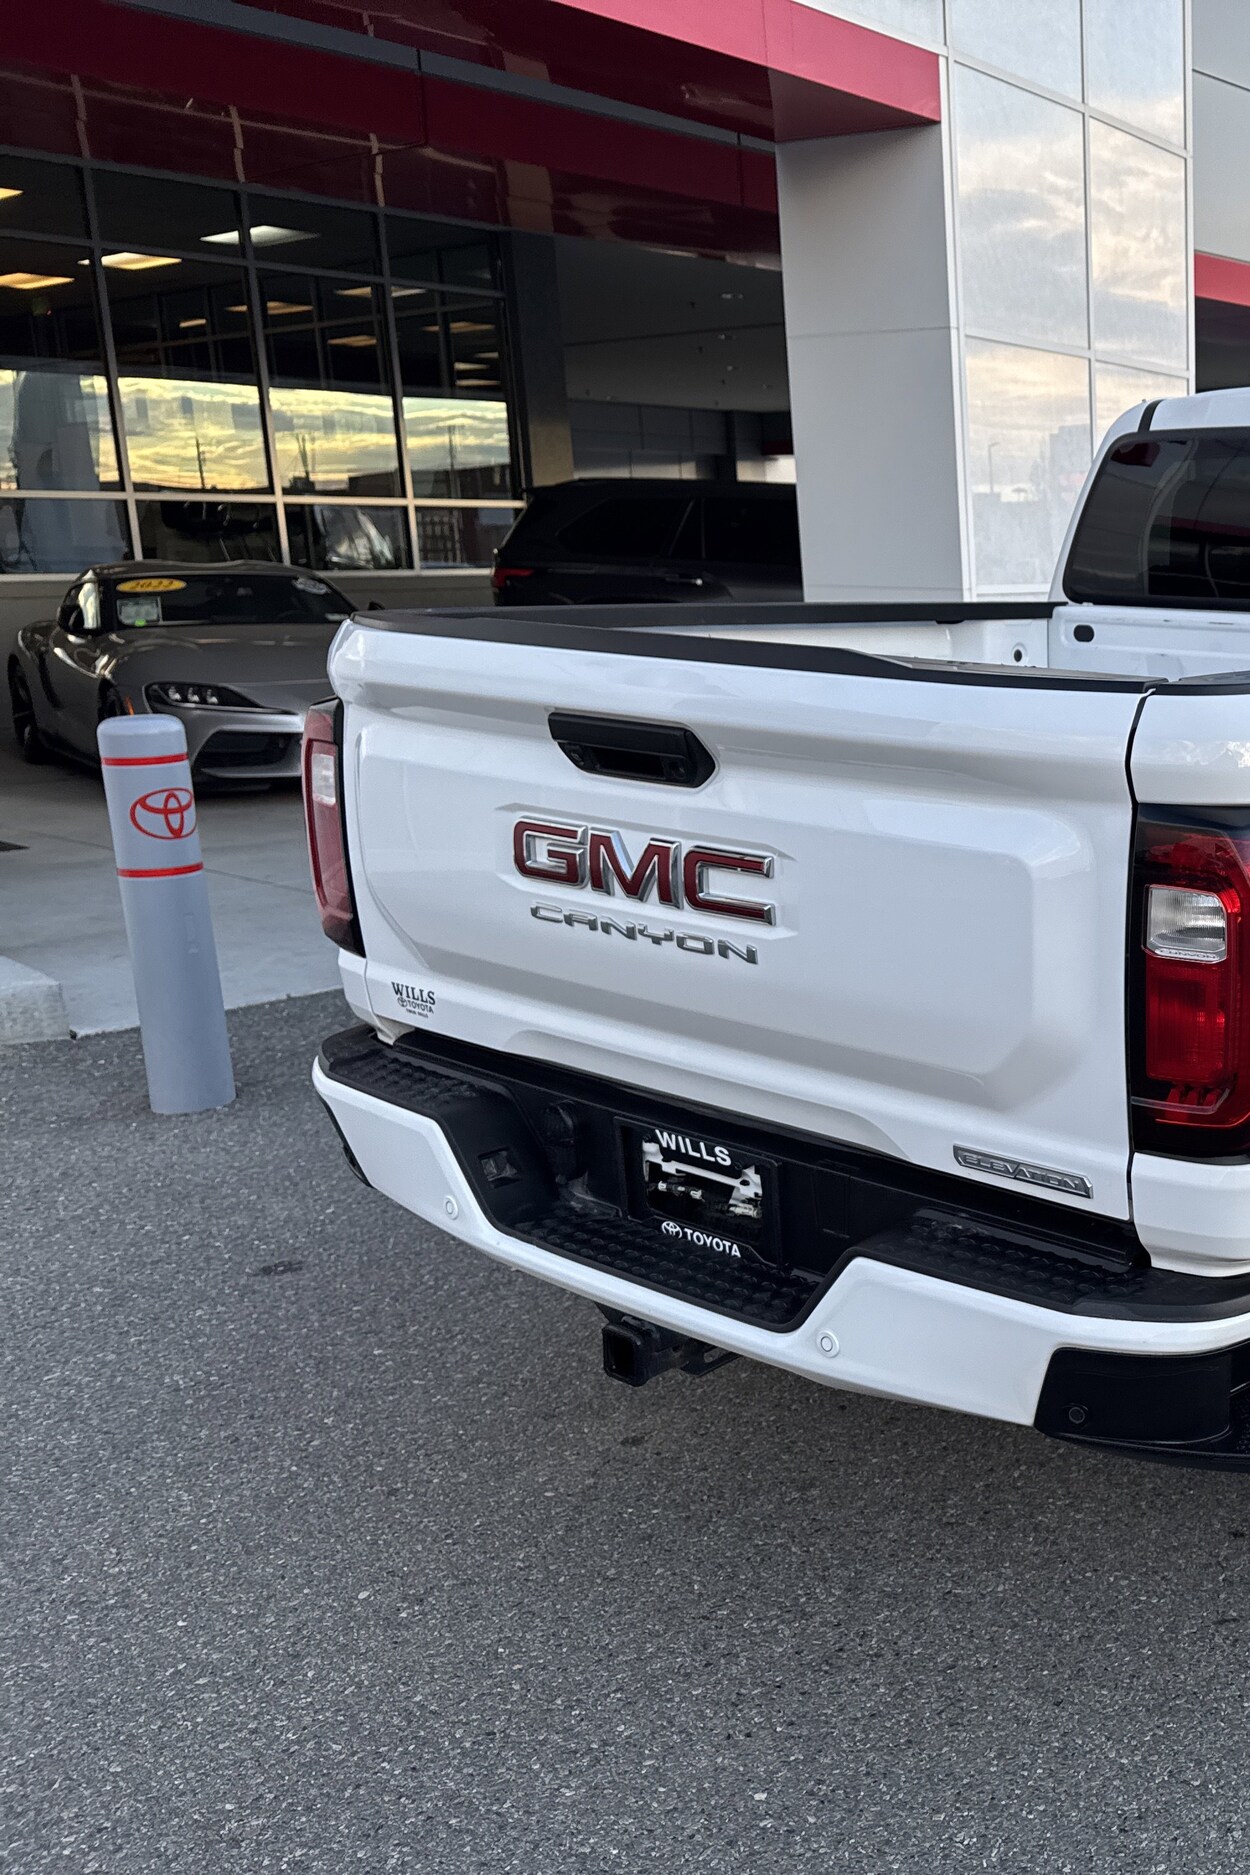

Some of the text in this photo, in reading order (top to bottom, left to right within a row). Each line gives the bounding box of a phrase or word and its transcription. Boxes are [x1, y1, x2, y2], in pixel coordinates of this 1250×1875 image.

[513, 816, 777, 926] GMC
[530, 902, 759, 965] CANYON
[391, 981, 436, 1005] WILLS
[407, 1000, 434, 1014] TOYOTA
[655, 1129, 732, 1166] WILLS
[683, 1228, 742, 1258] TOYOTA
